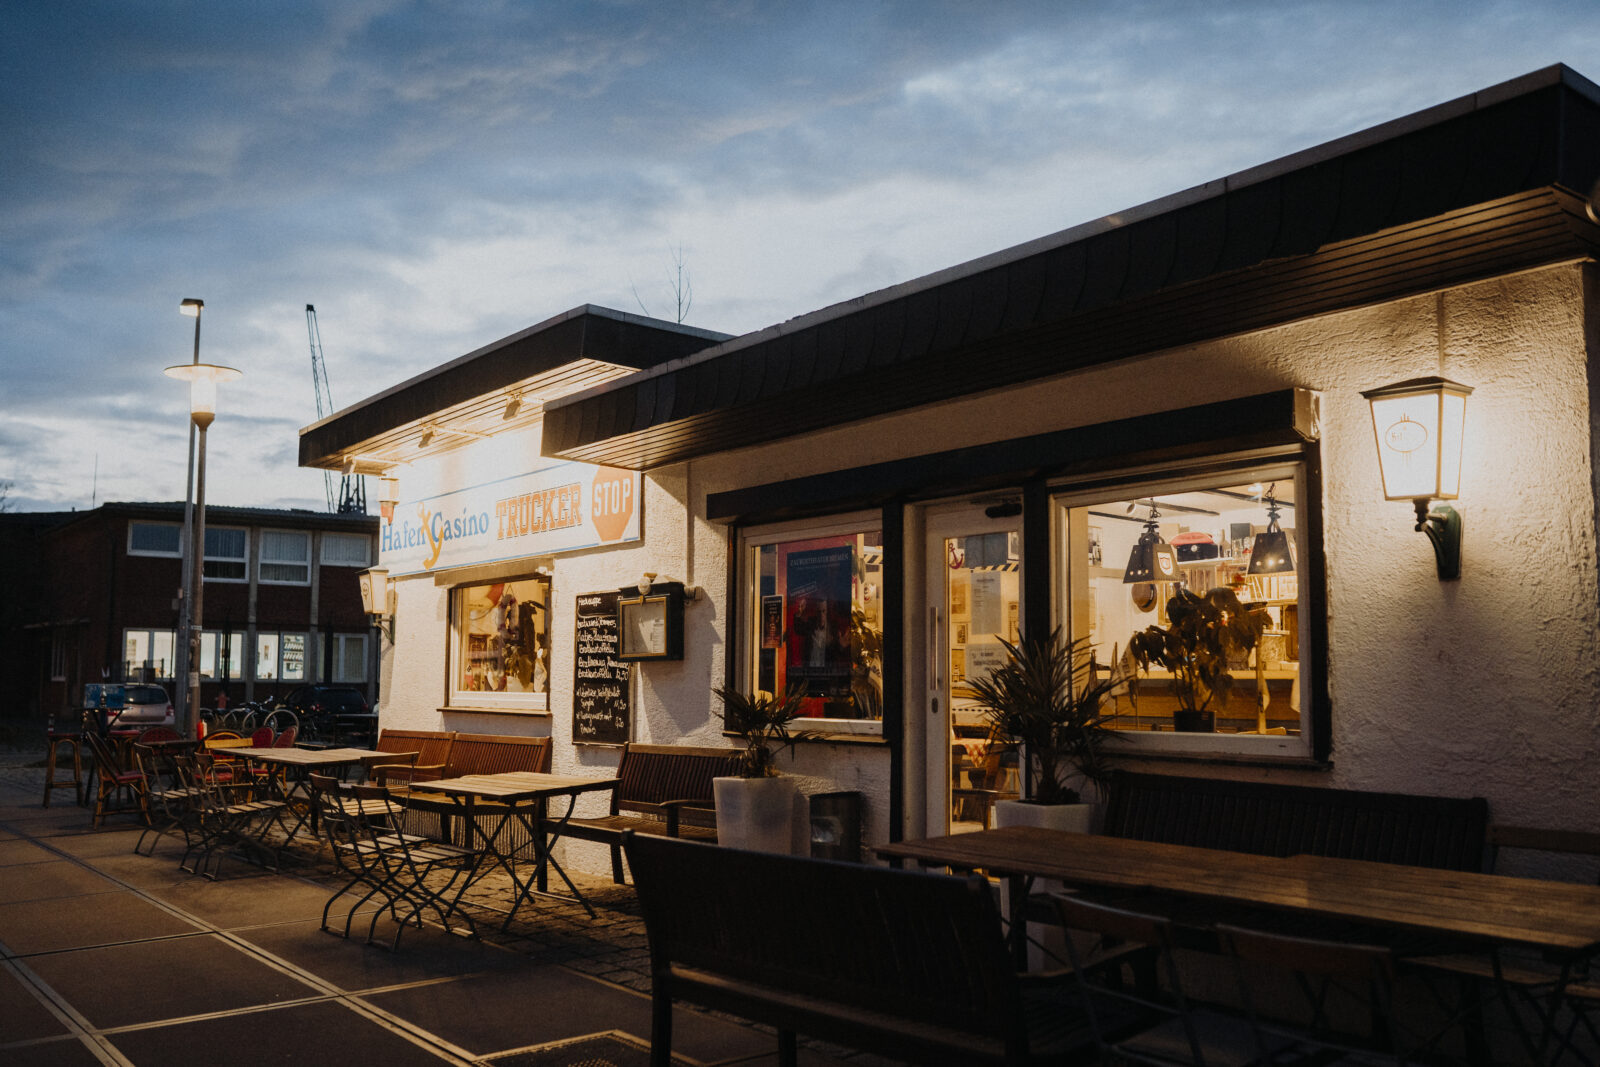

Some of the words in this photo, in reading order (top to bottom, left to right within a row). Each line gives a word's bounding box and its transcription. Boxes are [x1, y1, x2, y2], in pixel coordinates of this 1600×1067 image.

[381, 522, 426, 553] Hafen
[431, 507, 489, 543] Casino
[495, 482, 583, 540] TRUCKER
[593, 478, 631, 517] STOP
